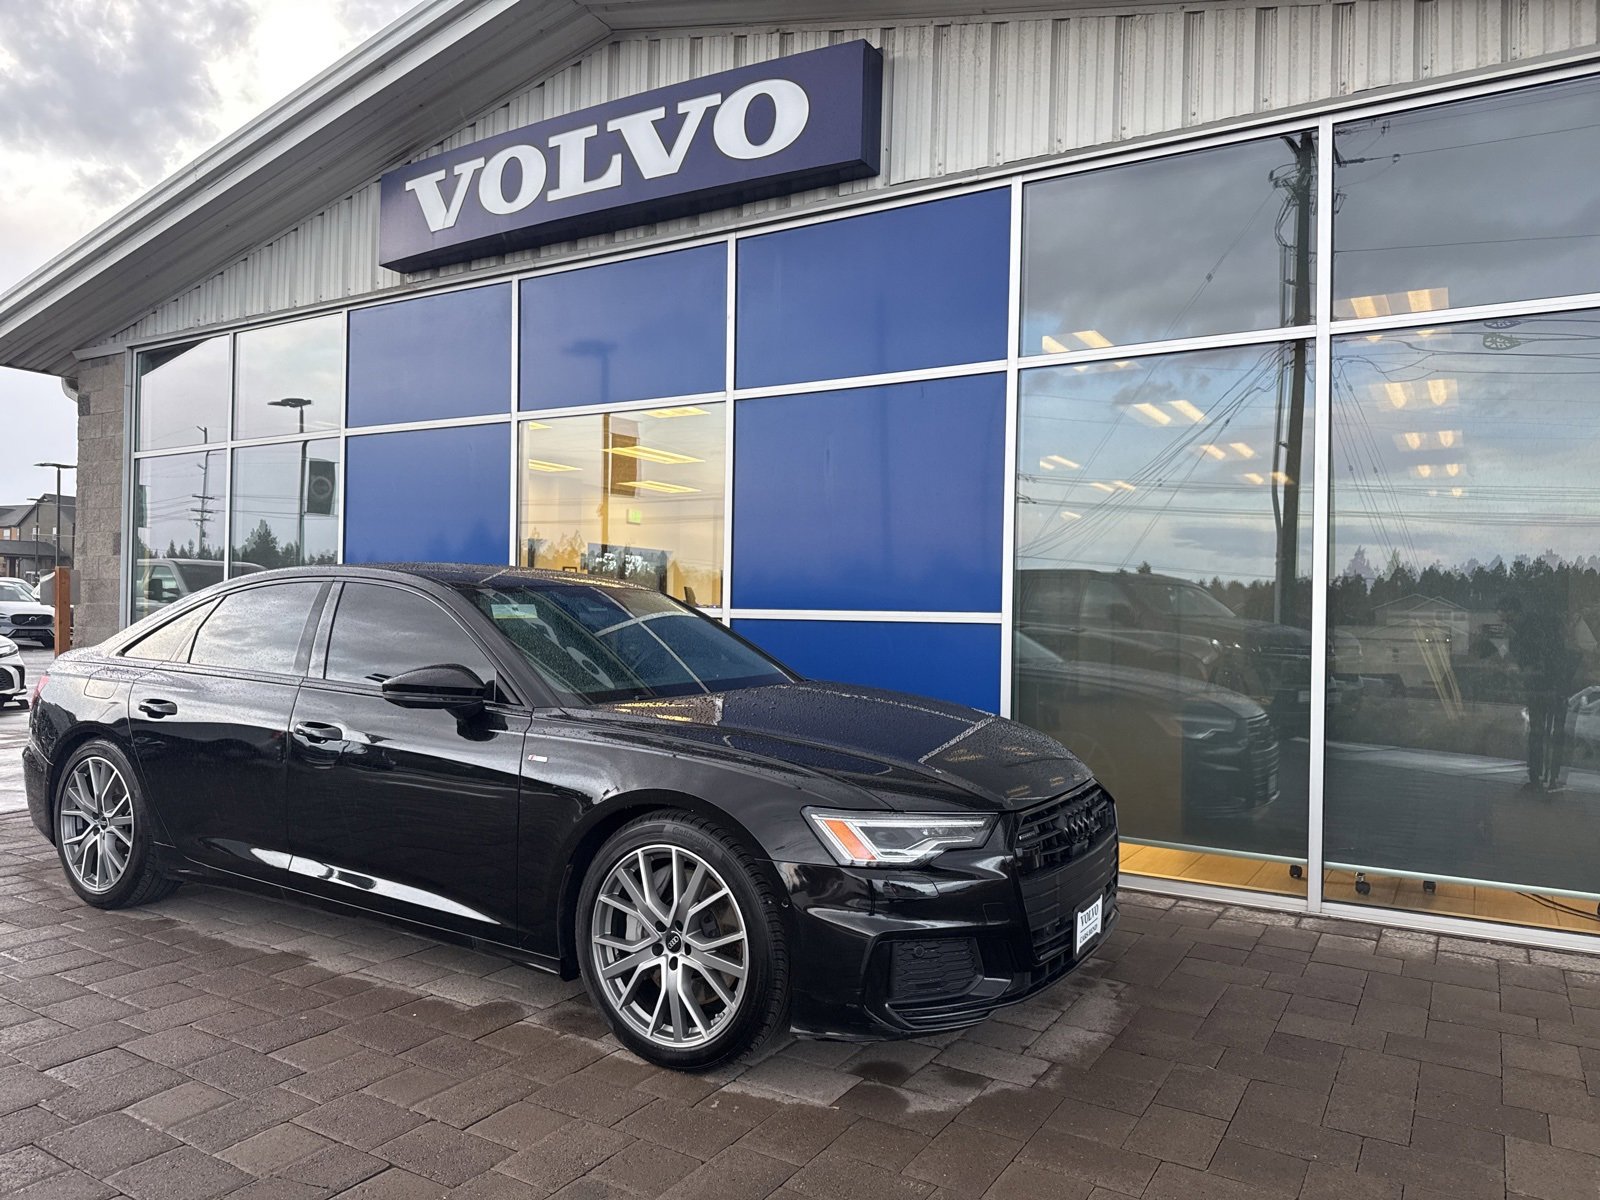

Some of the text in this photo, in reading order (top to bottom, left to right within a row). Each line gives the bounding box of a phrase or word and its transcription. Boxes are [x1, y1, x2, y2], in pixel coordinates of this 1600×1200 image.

[405, 78, 809, 233] VOLVO
[1080, 904, 1099, 926] VOLVO
[1079, 931, 1088, 943] CARS
